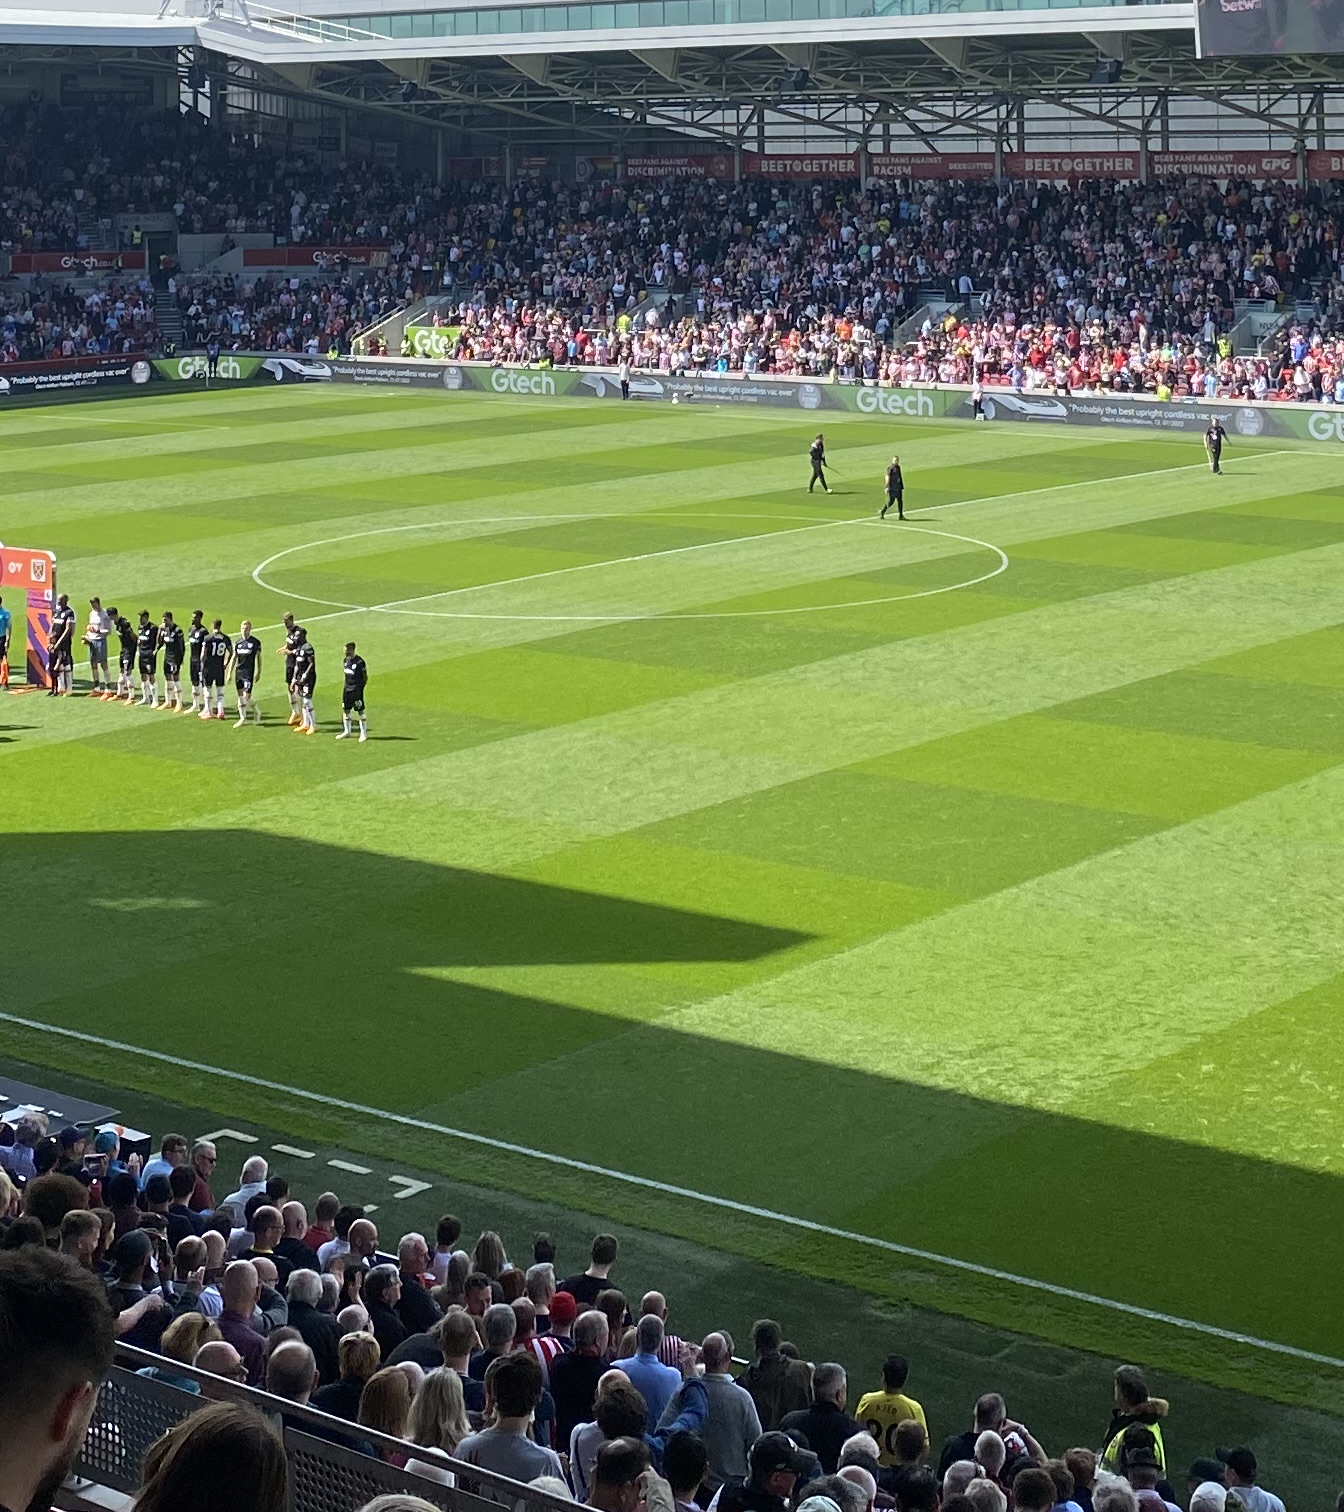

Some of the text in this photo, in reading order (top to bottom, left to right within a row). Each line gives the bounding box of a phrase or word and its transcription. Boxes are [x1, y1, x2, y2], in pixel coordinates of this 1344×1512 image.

[658, 158, 689, 166] AGAINST
[1175, 154, 1196, 162] FANS
[1261, 158, 1291, 170] GPG
[761, 159, 855, 173] BEETOGETHER
[873, 165, 912, 176] RACISM
[1025, 158, 1134, 171] BEETOGETHER
[1154, 164, 1257, 175] DISCRIMINATION
[627, 167, 705, 177] DISCRIMINATION
[491, 369, 555, 395] Gtech
[856, 387, 934, 417] Gtech
[1105, 406, 1117, 414] the
[1118, 406, 1135, 416] best
[1135, 409, 1163, 419] upright
[1163, 410, 1196, 420] cordless
[211, 642, 227, 657] 18
